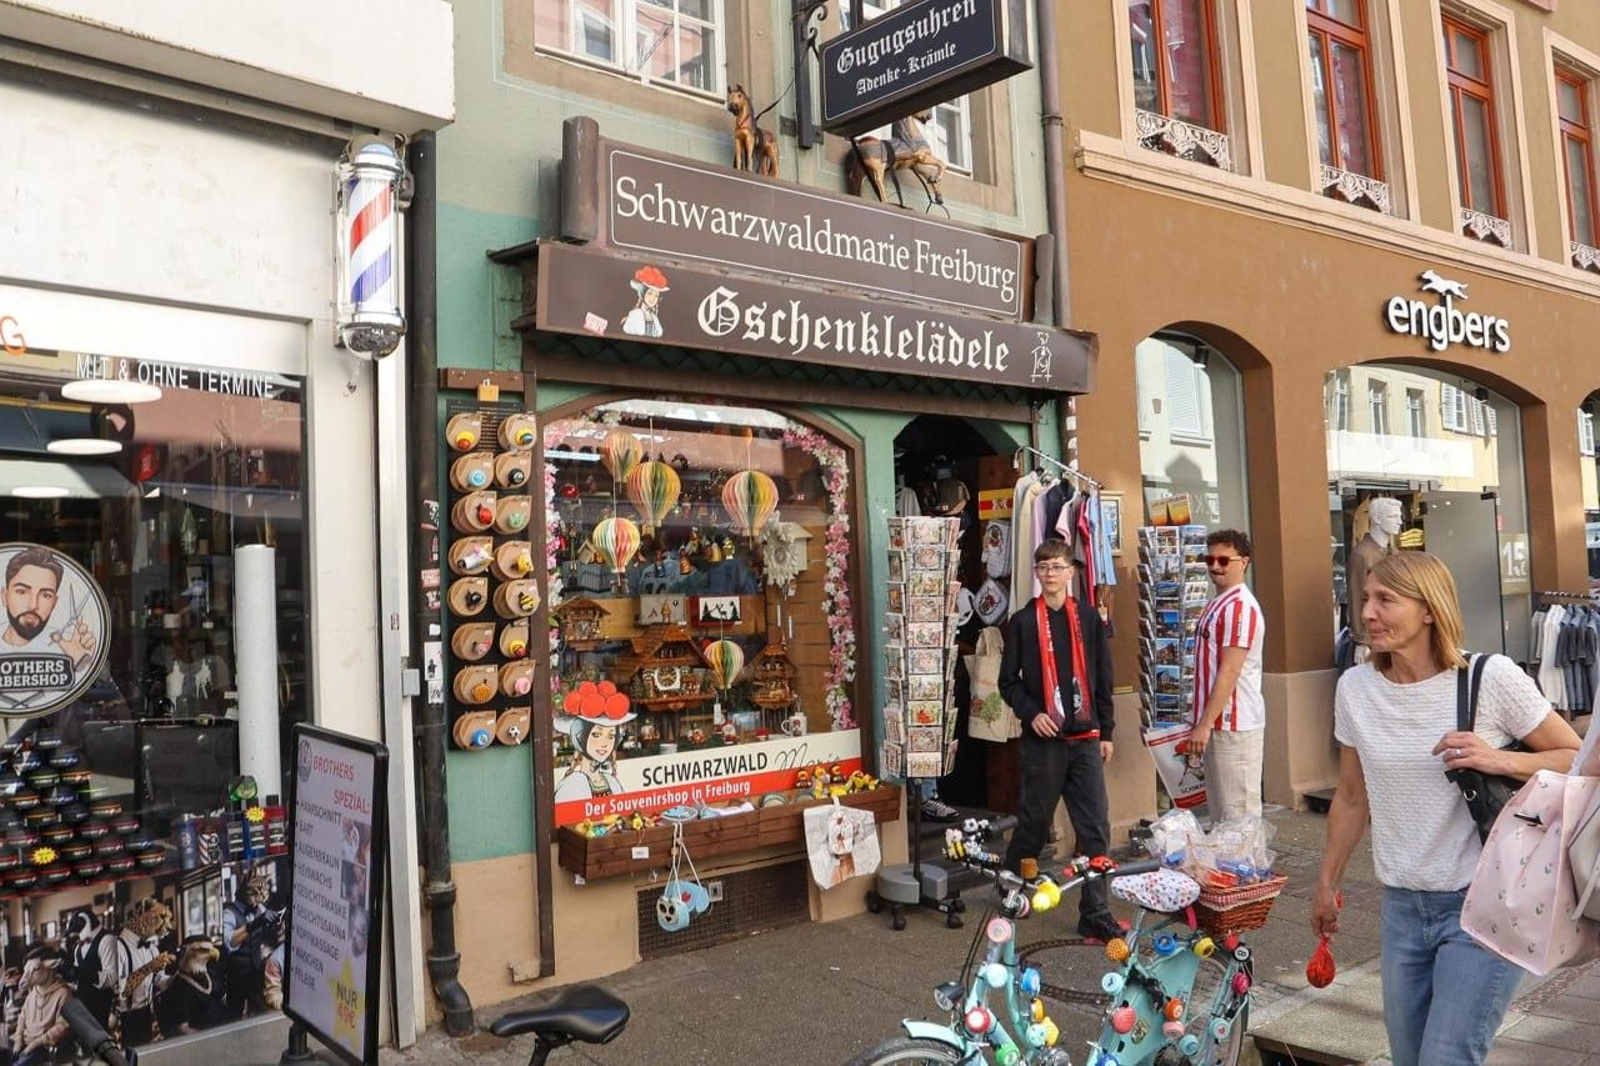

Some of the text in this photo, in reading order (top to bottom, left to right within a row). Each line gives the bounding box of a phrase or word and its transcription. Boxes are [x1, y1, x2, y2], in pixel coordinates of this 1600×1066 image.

[615, 175, 1016, 303] Schwarzwaldmarie Freiburg
[697, 286, 1010, 375] Gschenklelädele
[1387, 294, 1511, 352] engbers
[76, 354, 274, 399] MIT & OHNE TERMINE
[313, 755, 354, 780] BROTHERS
[642, 752, 768, 788] SCHWARZWALD
[585, 780, 751, 818] Der Souvenirshop in Freiburg
[337, 981, 358, 1010] NUR
